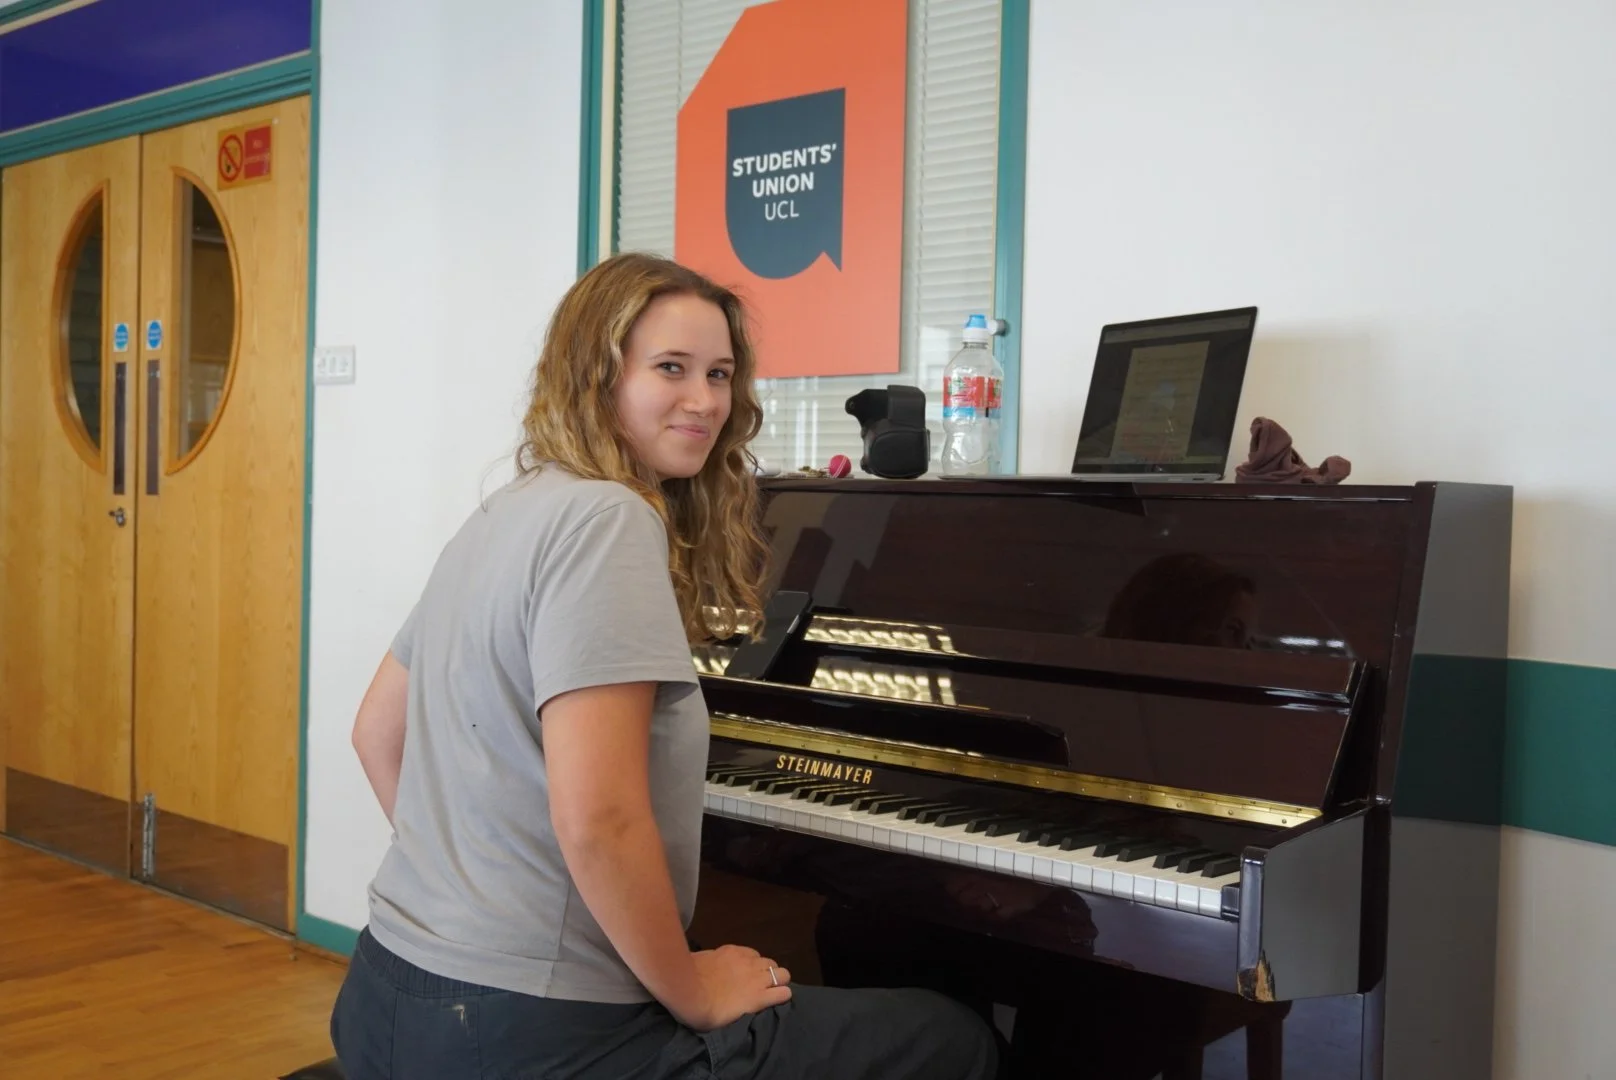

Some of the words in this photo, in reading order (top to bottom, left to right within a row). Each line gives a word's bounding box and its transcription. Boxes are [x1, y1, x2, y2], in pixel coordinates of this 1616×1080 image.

[752, 171, 815, 198] UNION
[764, 200, 800, 221] UCL
[776, 754, 873, 785] STEINMAYER
